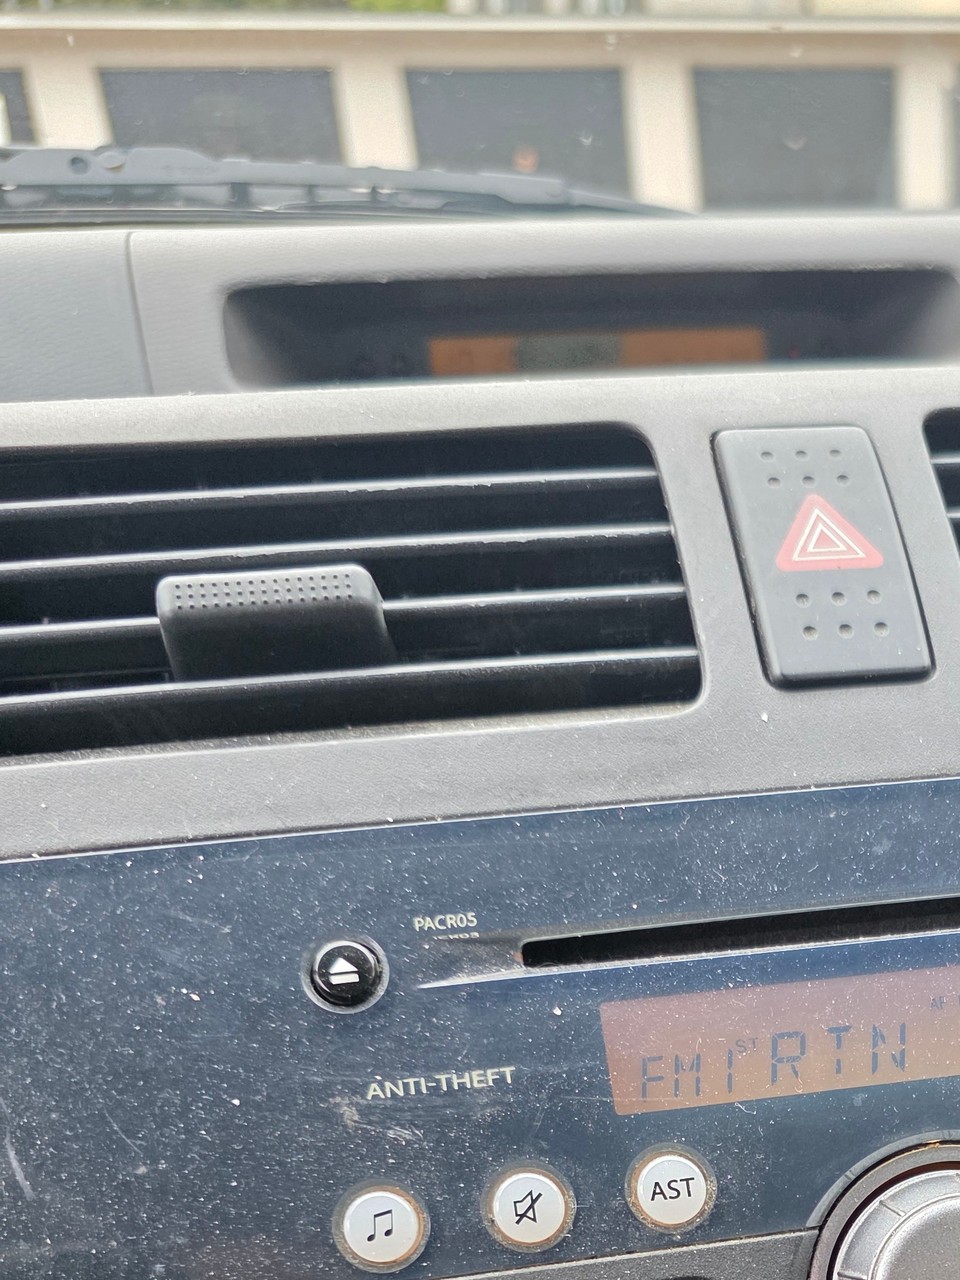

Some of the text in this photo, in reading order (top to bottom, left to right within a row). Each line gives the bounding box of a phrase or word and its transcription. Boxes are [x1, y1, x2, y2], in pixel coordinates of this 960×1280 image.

[414, 912, 478, 931] PACR05
[366, 1067, 515, 1100] ANTI-THEFT
[650, 1177, 695, 1202] AST
